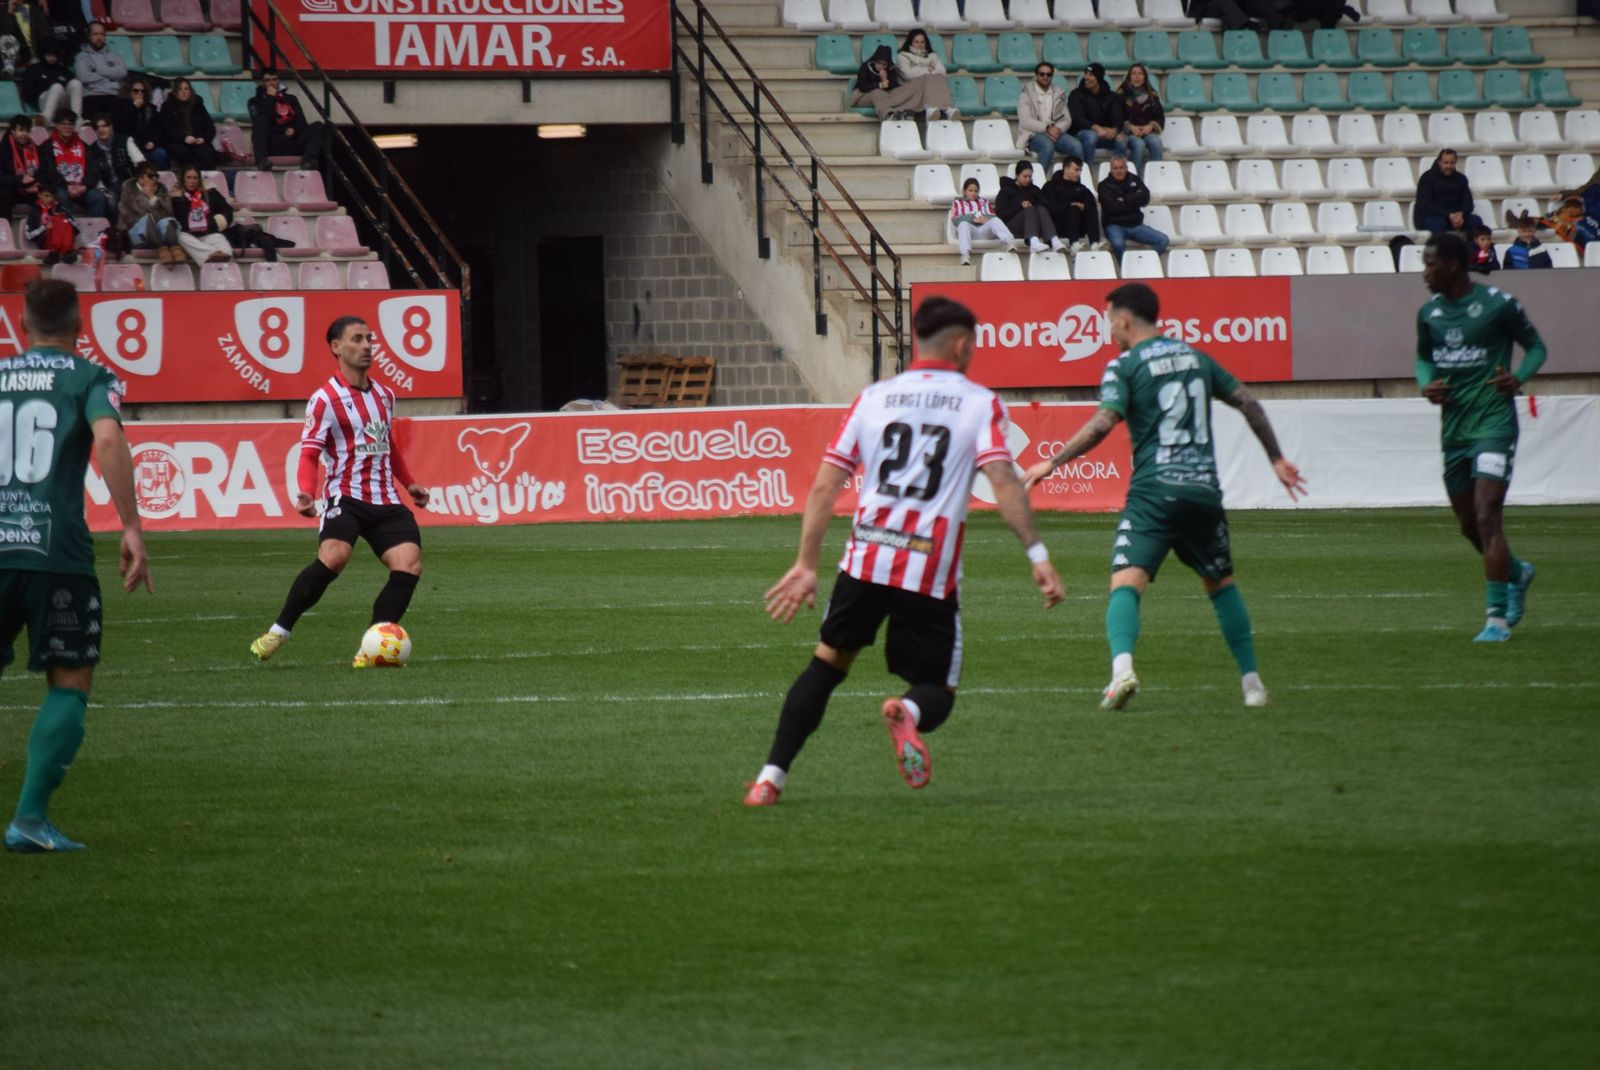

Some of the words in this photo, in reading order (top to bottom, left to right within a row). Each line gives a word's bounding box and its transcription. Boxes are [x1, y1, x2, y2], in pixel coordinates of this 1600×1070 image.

[374, 19, 566, 68] TAMAR,
[581, 46, 625, 66] S.A.
[116, 308, 148, 361] 8
[258, 306, 289, 360] 8
[402, 305, 432, 358] 8
[217, 333, 270, 394] ZAMORA
[1158, 378, 1209, 446] 21
[577, 421, 791, 464] Escuela
[876, 422, 951, 500] 23
[0, 490, 31, 502] UNTA
[9, 502, 52, 513] GALICIA
[584, 468, 794, 514] infantil
[1041, 482, 1069, 494] 1269
[1072, 482, 1094, 494] OM
